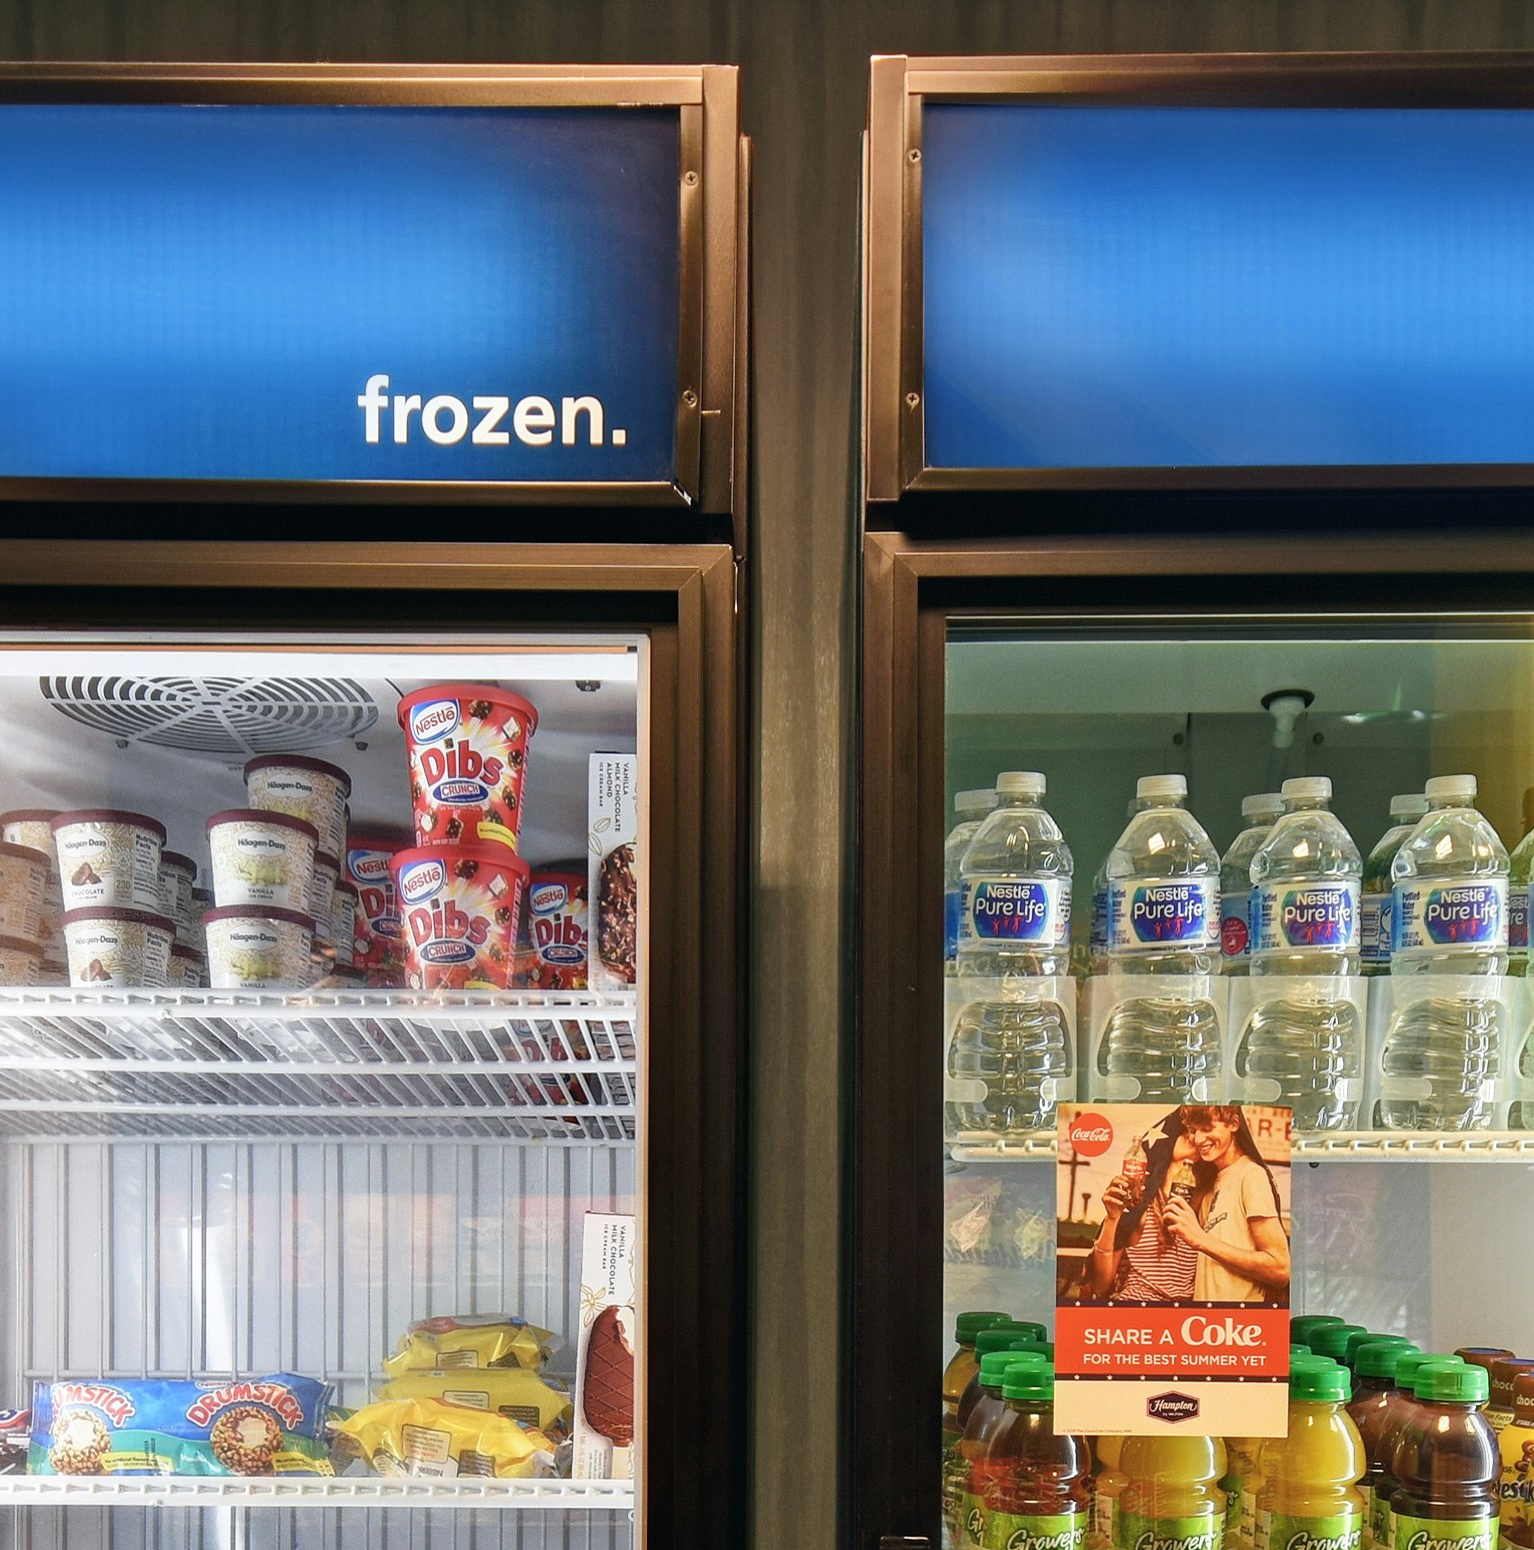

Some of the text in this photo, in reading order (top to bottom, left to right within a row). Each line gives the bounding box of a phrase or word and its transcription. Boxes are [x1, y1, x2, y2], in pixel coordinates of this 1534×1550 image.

[357, 374, 626, 445] frozen.
[420, 740, 503, 787] Dibs
[441, 784, 479, 798] CRUNCH
[117, 880, 130, 889] 230
[409, 899, 491, 944] Dibs
[975, 899, 1044, 922] Pure Life
[1134, 902, 1203, 922] Pure Life
[1428, 903, 1497, 926] Pure Life
[428, 944, 465, 959] CRUNCH
[1071, 1128, 1110, 1142] Coca-Cola
[609, 1247, 617, 1295] CHOCOLATE
[1084, 1315, 1262, 1346] SHARE A Coke
[1083, 1354, 1266, 1367] FOR THE BEST SUMMER YET
[187, 1384, 303, 1427] DRUMSTICK
[1150, 1399, 1197, 1414] Hampton
